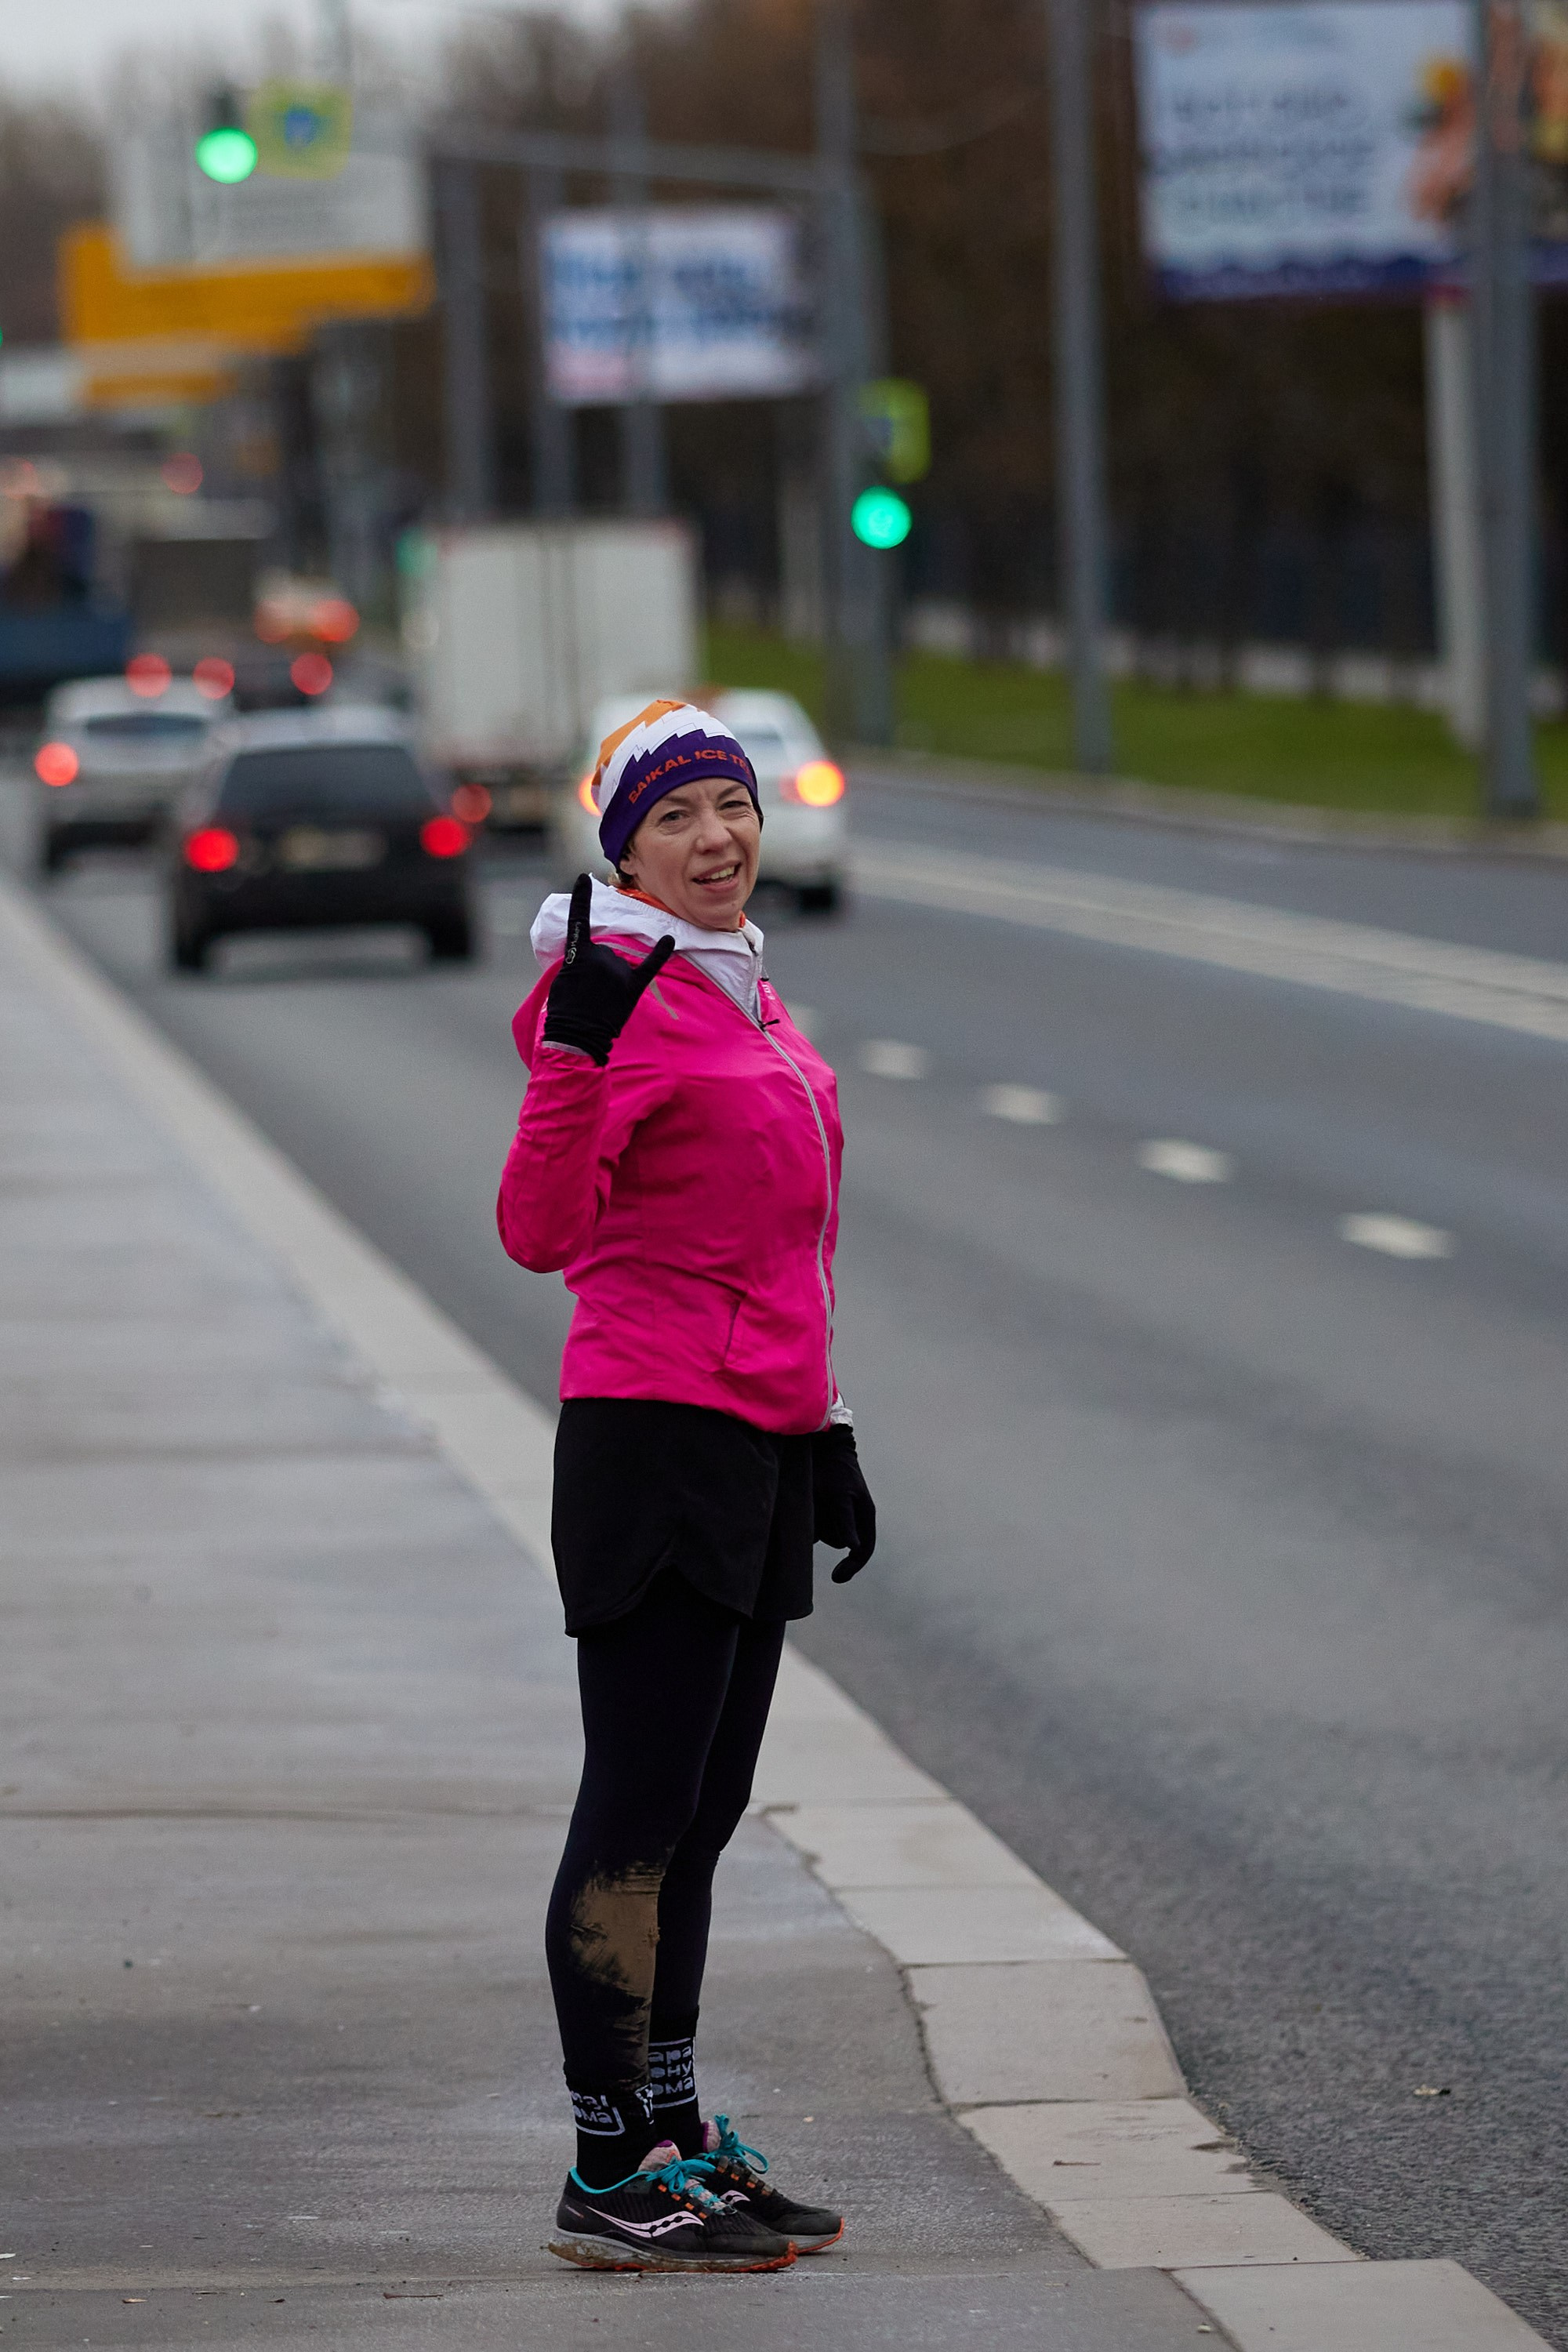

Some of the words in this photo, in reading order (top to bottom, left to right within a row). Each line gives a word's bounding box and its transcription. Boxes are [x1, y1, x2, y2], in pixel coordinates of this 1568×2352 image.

[628, 755, 691, 804] BAIKAL
[695, 749, 728, 760] ICE
[648, 2045, 692, 2064] ара
[650, 2060, 692, 2078] ону
[652, 2077, 695, 2096] ома
